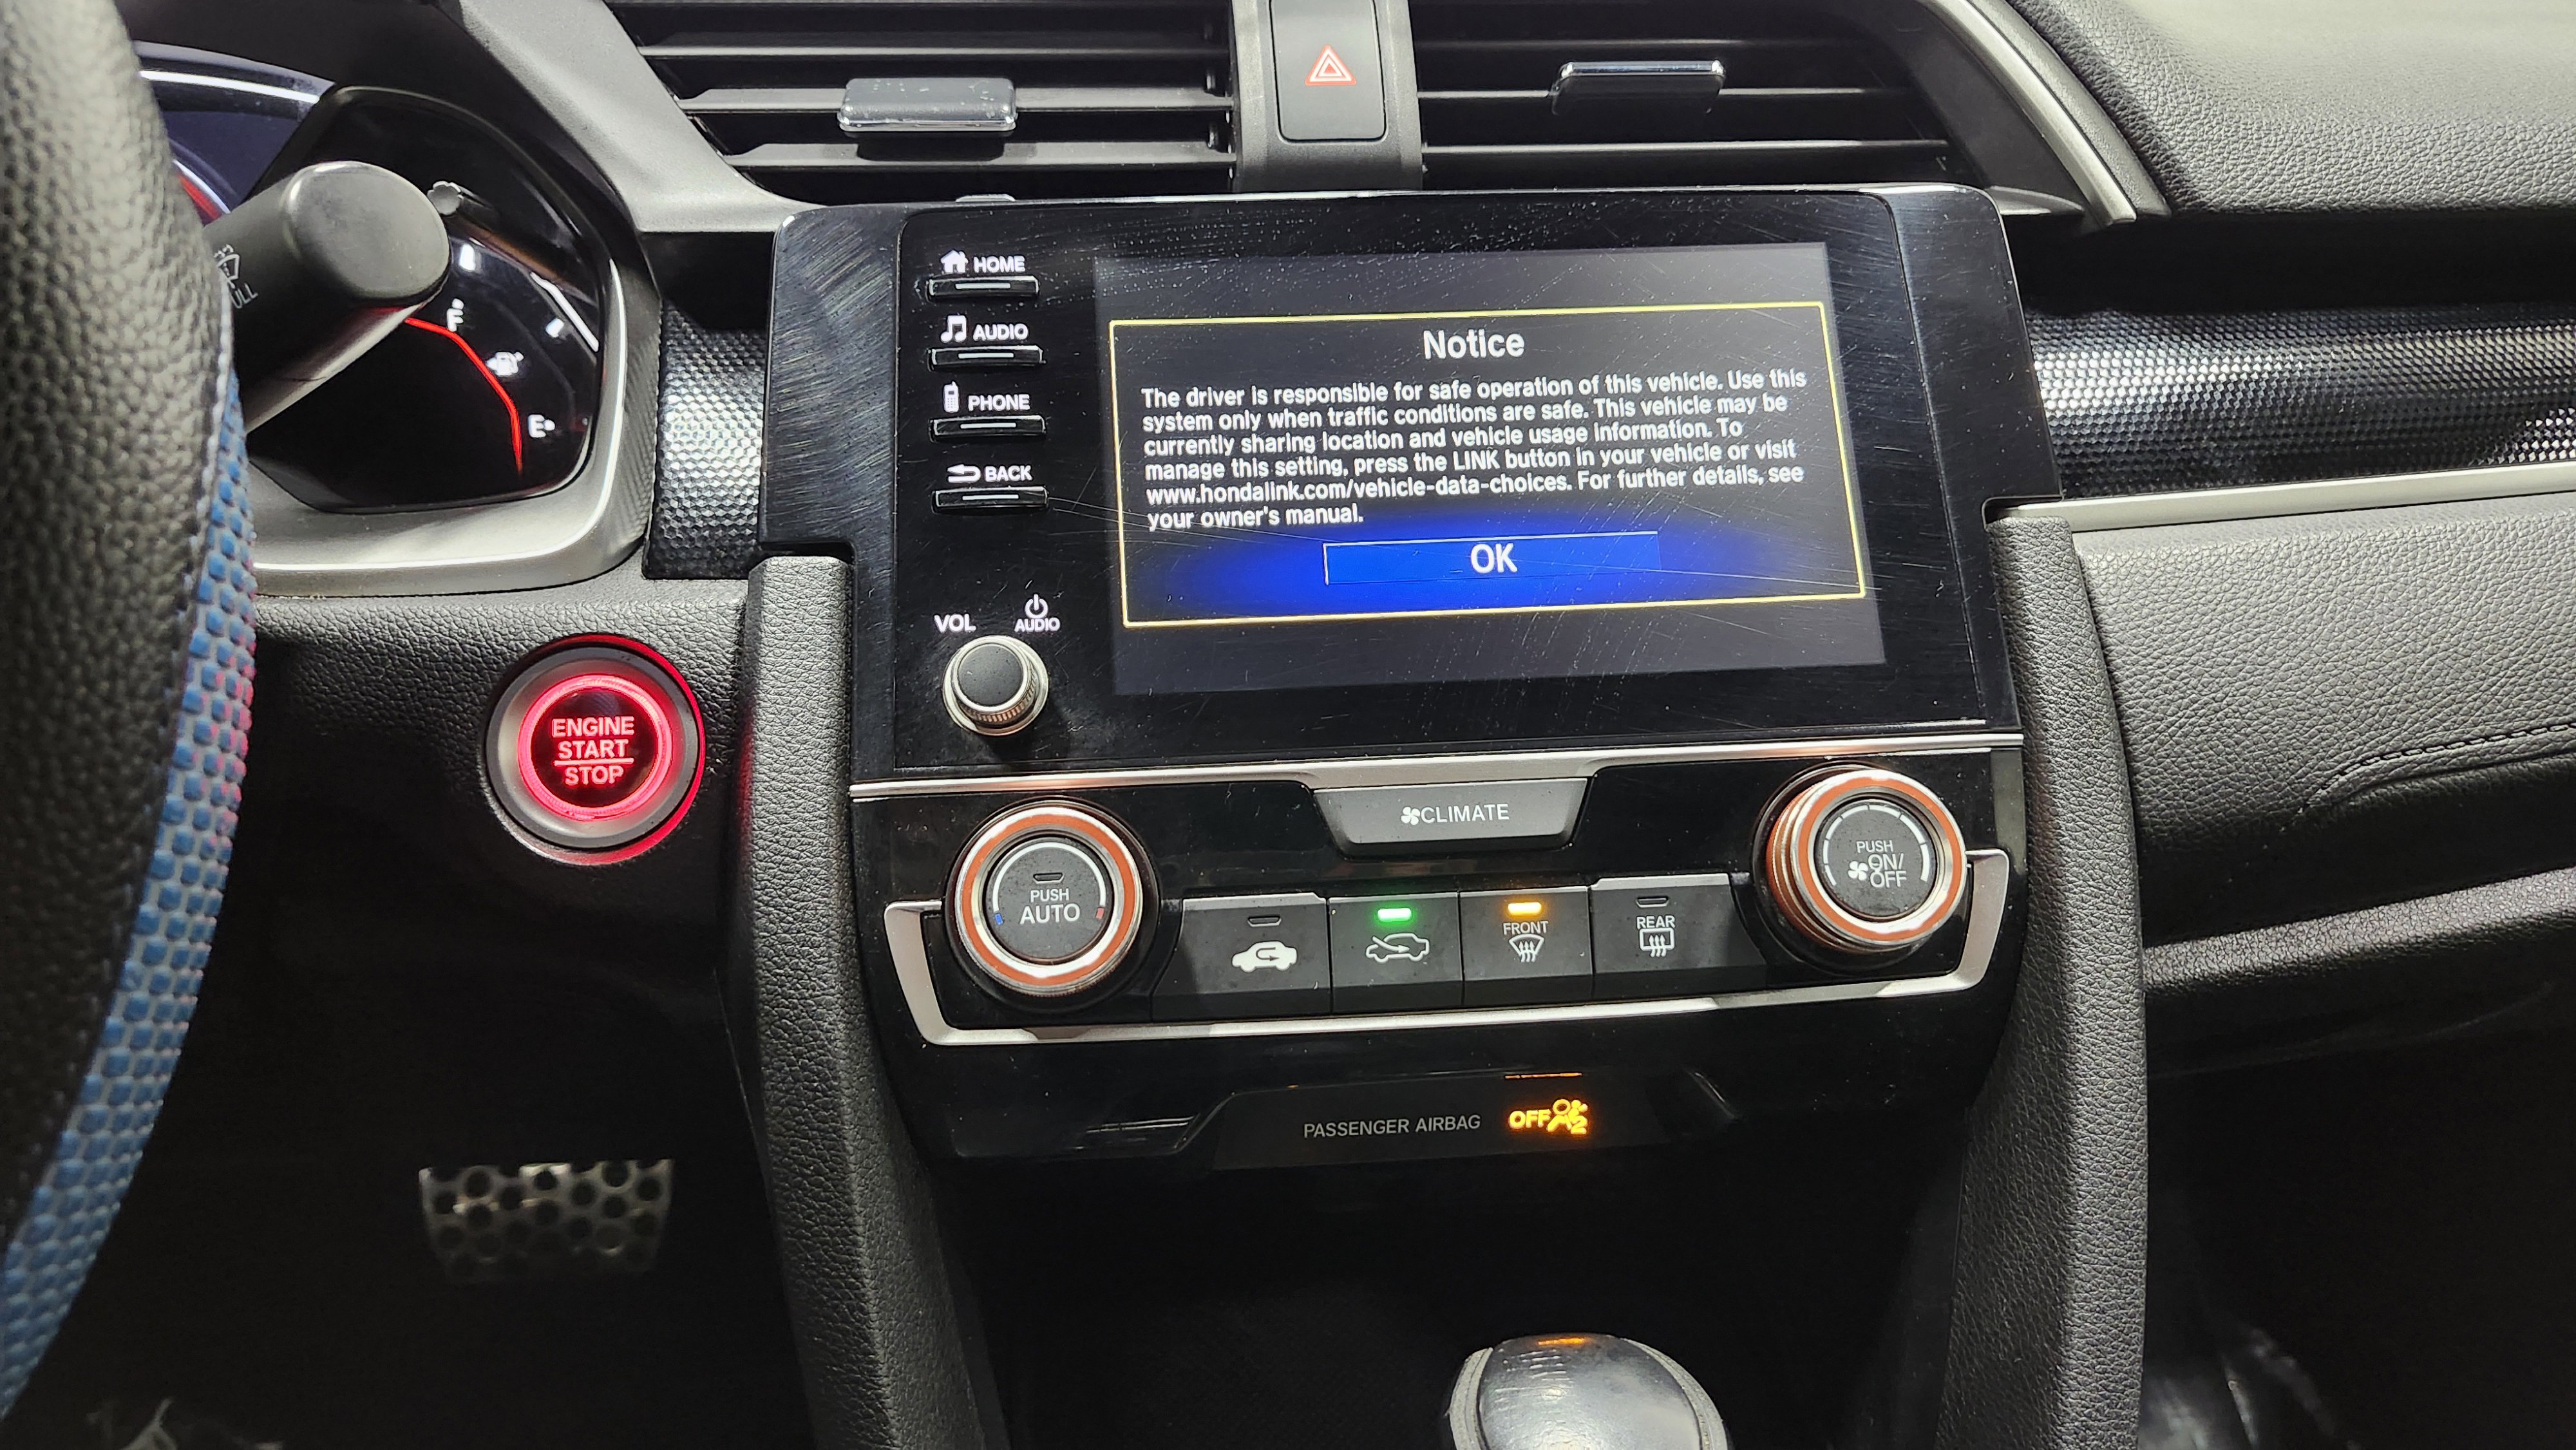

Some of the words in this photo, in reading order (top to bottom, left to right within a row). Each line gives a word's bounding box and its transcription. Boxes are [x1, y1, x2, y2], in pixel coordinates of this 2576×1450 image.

[973, 255, 1026, 273] HOME
[231, 283, 258, 308] ULL
[972, 323, 1028, 342] AUDIO
[1423, 328, 1525, 361] Notice
[1141, 388, 1180, 408] The
[1186, 386, 1245, 408] driver
[1252, 385, 1268, 406] is
[1274, 382, 1388, 406] responsible
[1394, 381, 1423, 402] for
[1429, 379, 1472, 400] safe
[1477, 377, 1573, 400] operation
[1578, 374, 1600, 395] of
[1605, 373, 1642, 394] this
[1647, 371, 1723, 393] vehicle.
[1727, 370, 1764, 390] Use
[1769, 368, 1806, 388] this
[968, 394, 1030, 412] PHONE
[1142, 411, 1213, 434] system
[1218, 409, 1262, 431] only
[1267, 408, 1322, 429] when
[1327, 406, 1388, 426] traffic
[1394, 403, 1497, 425] conditions
[1502, 404, 1536, 422] are
[1541, 399, 1589, 421] safe.
[1593, 397, 1636, 419] This
[1640, 395, 1712, 417] vehicle
[1716, 395, 1757, 415] may
[1762, 391, 1788, 412] be
[1143, 433, 1235, 457] currently
[1241, 431, 1316, 455] sharing
[1323, 429, 1404, 451] location
[1408, 428, 1446, 449] and
[1452, 425, 1523, 446] vehicle
[1529, 426, 1588, 445] usage
[1593, 419, 1713, 442] information.
[1716, 417, 1743, 437] To
[1145, 462, 1225, 481] manage
[1231, 458, 1269, 478] this
[1274, 456, 1349, 477] setting,
[1354, 455, 1408, 476] press
[1414, 452, 1447, 472] the
[1453, 449, 1501, 471] LINK
[1505, 448, 1570, 469] button
[1576, 447, 1595, 467] in
[1600, 449, 1645, 467] your
[1651, 442, 1722, 464] vehicle
[1727, 443, 1750, 460] or
[1754, 438, 1797, 460] visit
[985, 465, 1032, 482] BACK
[1146, 473, 1572, 505] www.hondalink.com/vehicle-data-choices.
[1578, 470, 1611, 490] For
[1616, 467, 1687, 489] further
[1692, 464, 1764, 486] details,
[1768, 466, 1804, 483] see
[1147, 511, 1195, 532] your
[1200, 505, 1280, 527] owner's
[1285, 502, 1364, 525] manual.
[1471, 543, 1518, 574] OK
[934, 614, 976, 633] VOL
[1014, 617, 1061, 632] AUDIO
[552, 716, 634, 737] ENGINE
[558, 739, 629, 759] START
[565, 766, 624, 786] STOP
[1421, 804, 1510, 824] CLIMATE
[1856, 840, 1893, 853] PUSH
[1870, 871, 1907, 889] OFF
[1030, 888, 1069, 903] PUSH
[1019, 903, 1080, 925] AUTO
[1636, 915, 1676, 928] REAR
[1502, 920, 1549, 935] FRONT
[1304, 1118, 1409, 1138] PASSENGER
[1415, 1115, 1481, 1132] AIRBAG
[1509, 1109, 1551, 1129] OFF
